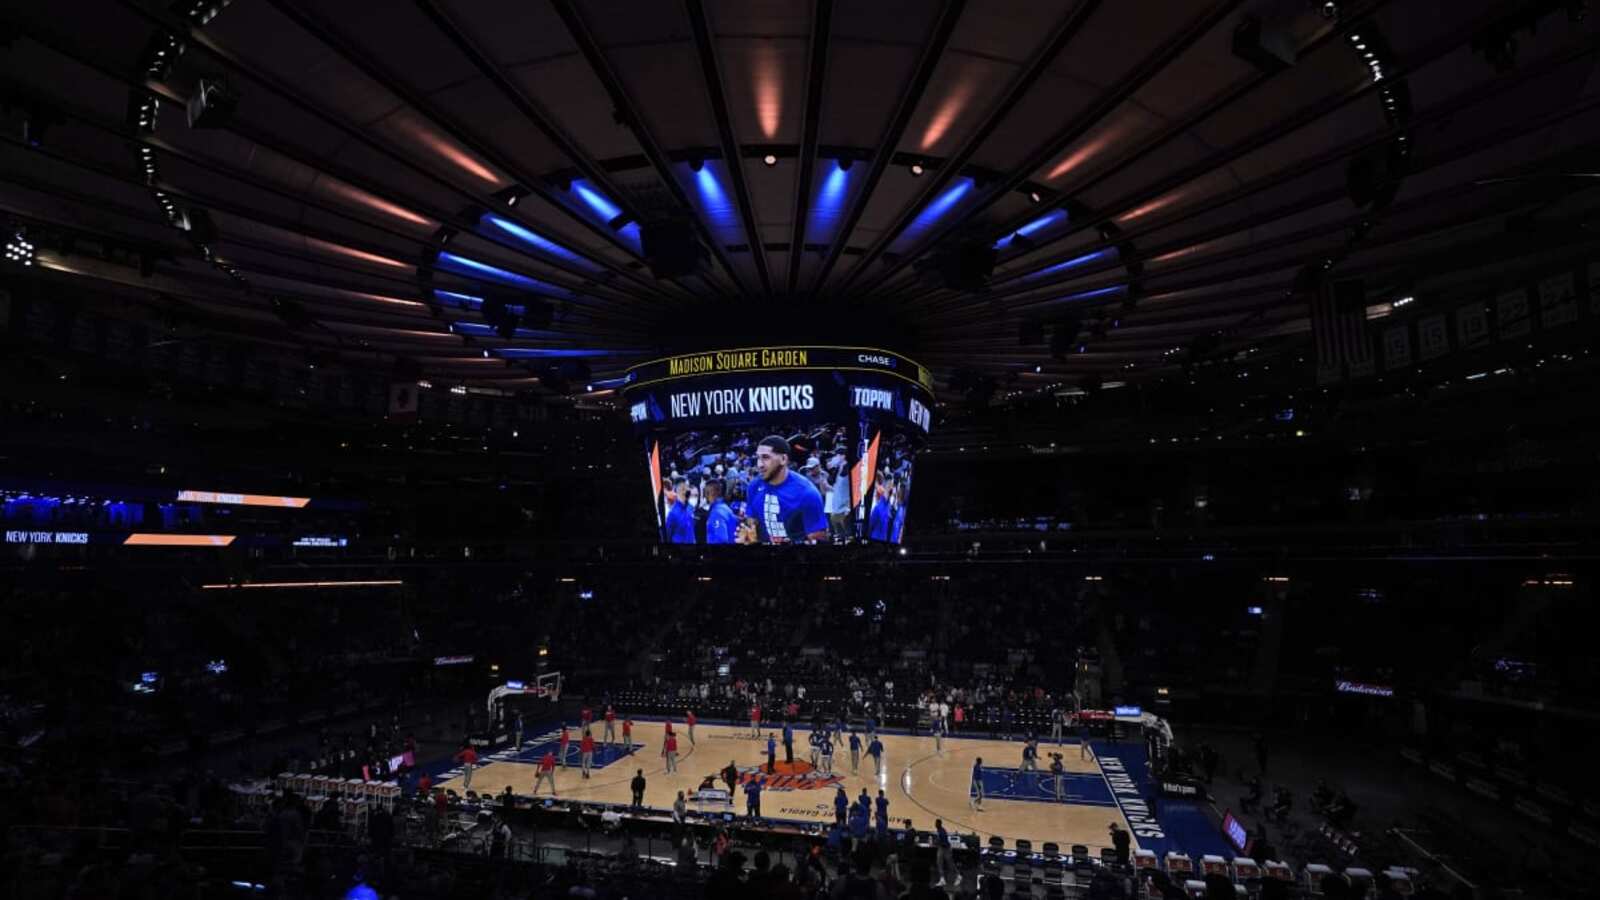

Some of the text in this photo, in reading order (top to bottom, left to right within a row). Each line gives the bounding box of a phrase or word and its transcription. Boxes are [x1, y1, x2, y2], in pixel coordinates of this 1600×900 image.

[858, 354, 891, 366] CHASE
[670, 385, 815, 418] NEW YORK KNICKS
[854, 387, 893, 410] TOPPIN
[6, 530, 89, 544] NEW YORK KNICKS
